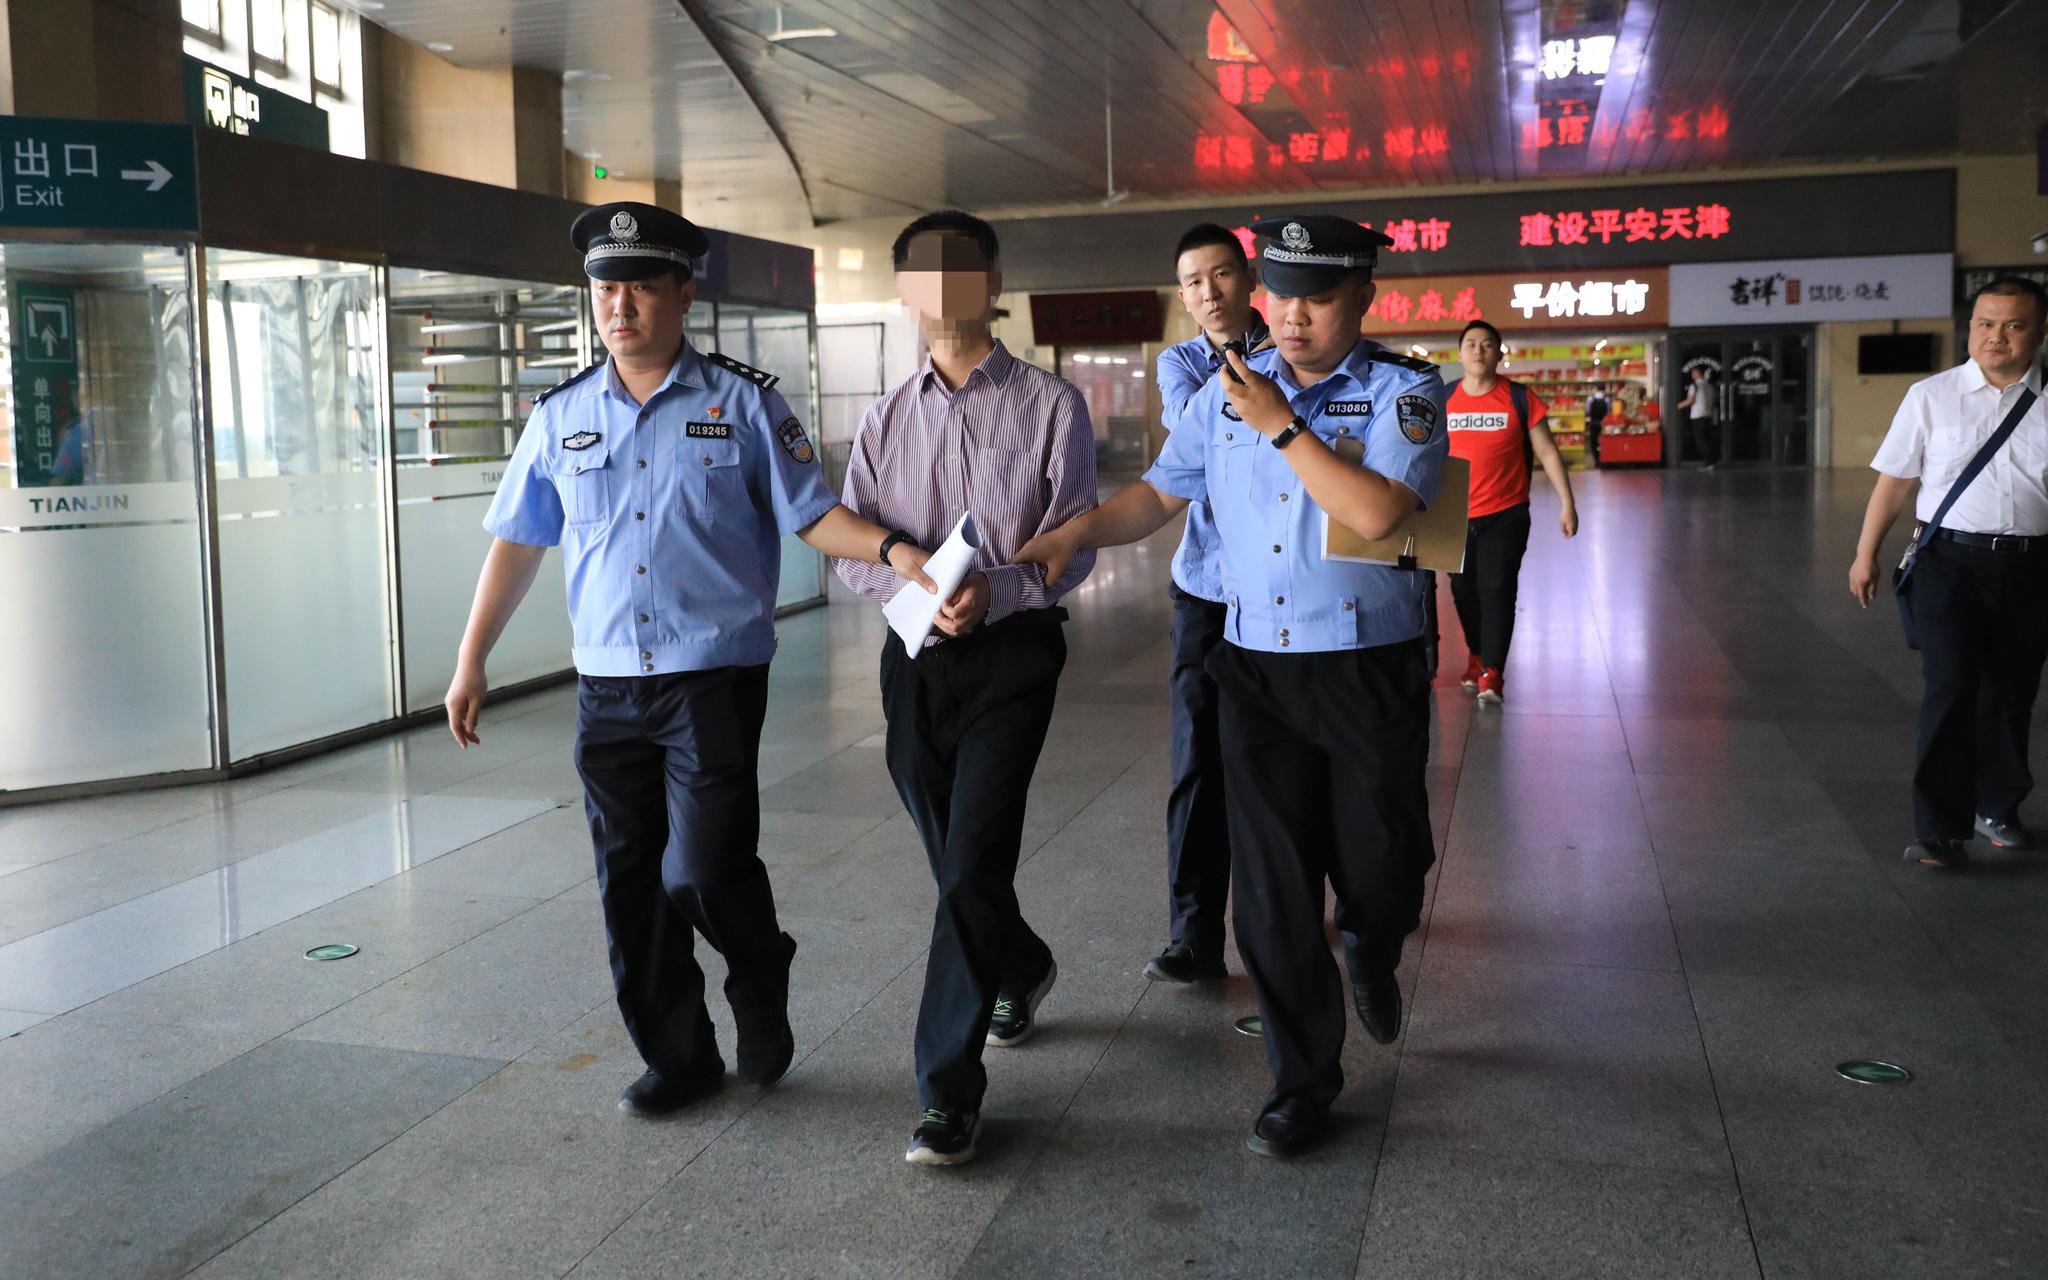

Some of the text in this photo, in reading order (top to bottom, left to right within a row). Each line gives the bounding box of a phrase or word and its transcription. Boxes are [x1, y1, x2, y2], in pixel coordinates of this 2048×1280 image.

[14, 137, 99, 178] 出口
[15, 184, 65, 207] Exit
[1519, 203, 1731, 247] 建设平安天津
[1369, 285, 1483, 324] 街麻花
[1510, 279, 1650, 319] 平价超市
[1328, 403, 1368, 413] 013080
[1449, 414, 1505, 429] adidas
[34, 377, 52, 471] 单向出口
[689, 425, 727, 436] 019245
[29, 494, 129, 513] TIANJIN
